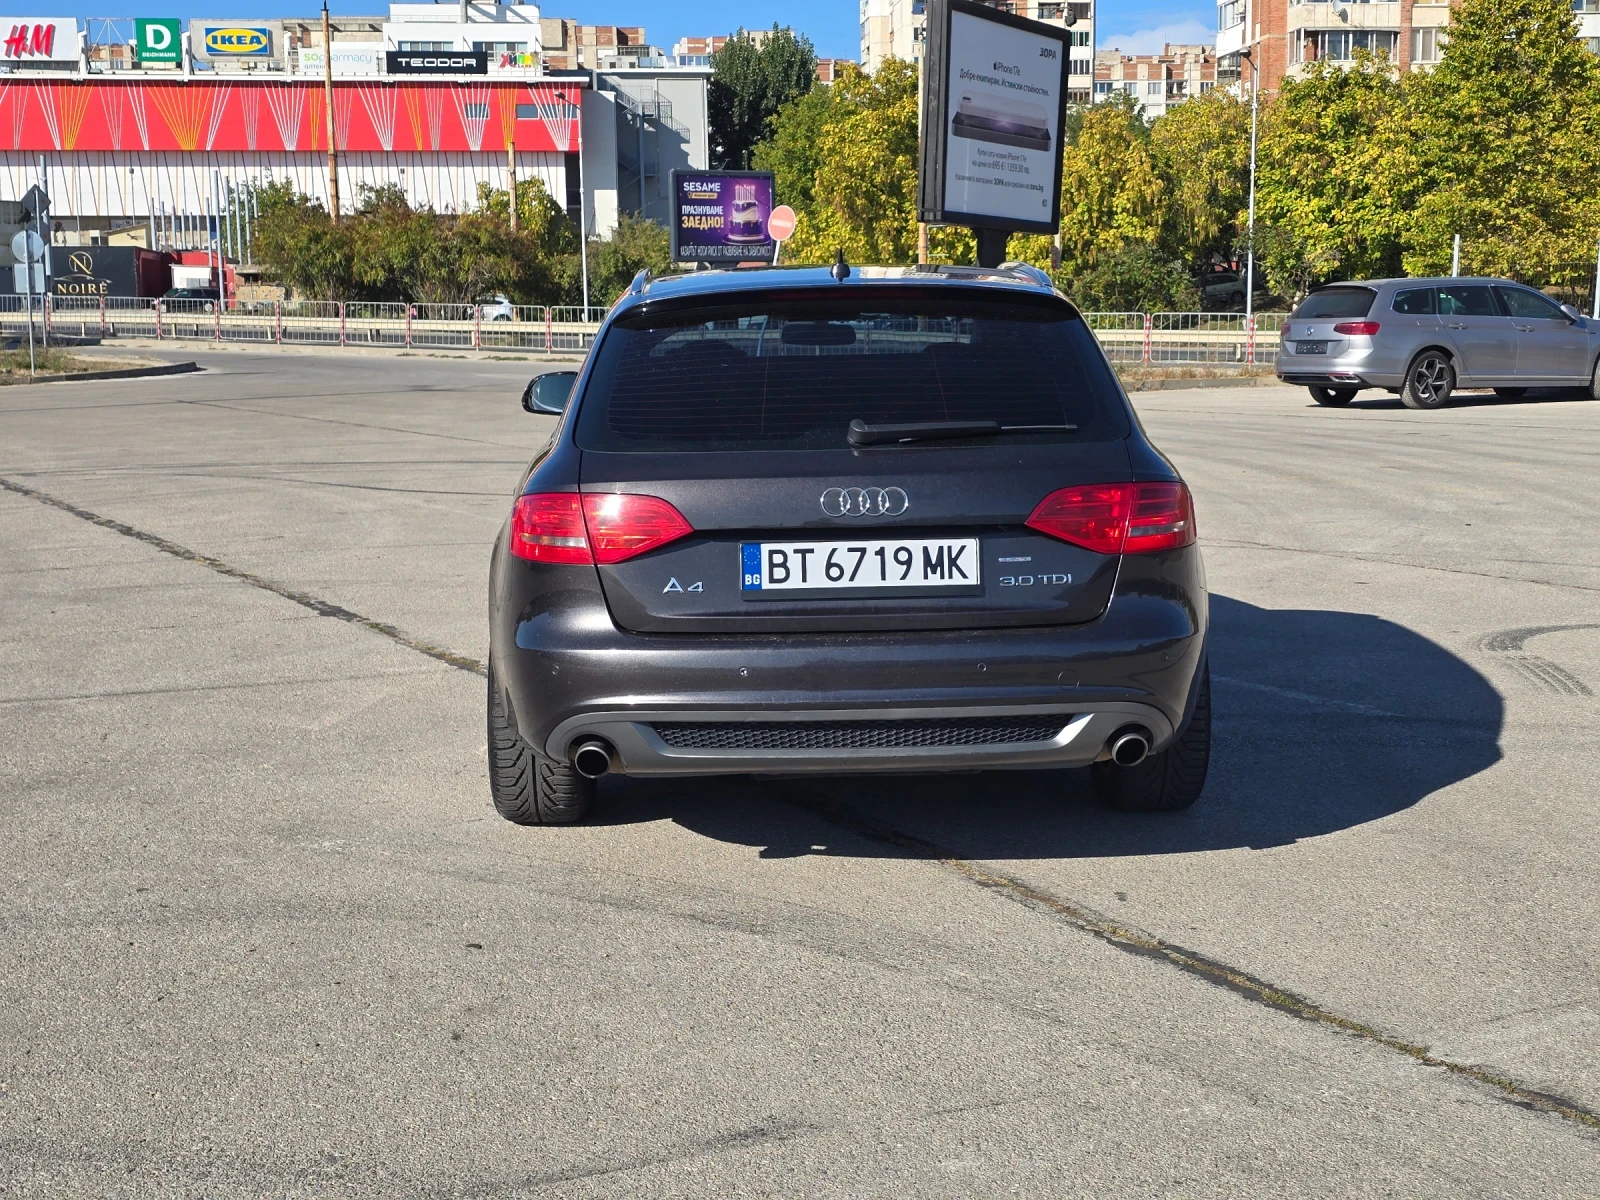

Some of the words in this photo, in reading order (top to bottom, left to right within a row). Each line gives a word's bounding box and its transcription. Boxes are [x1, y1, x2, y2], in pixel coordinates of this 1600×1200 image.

[3, 23, 53, 59] H&M
[211, 35, 263, 45] IKEA
[304, 53, 372, 64] soparmacy
[1039, 47, 1057, 60] ЗОРА
[397, 58, 477, 67] TEODOR
[996, 61, 1013, 75] iPhone
[959, 68, 976, 82] Добре
[992, 160, 1001, 170] 695
[683, 182, 721, 192] SESAME
[994, 177, 1004, 187] ЗОРА
[1030, 183, 1044, 193] zora.bg
[682, 205, 724, 215] ПРАЗНУВАМЕ
[682, 216, 725, 230] ЗАЕДНО!
[767, 548, 814, 584] BT
[823, 545, 914, 582] 6719
[923, 543, 970, 580] MK
[744, 574, 761, 585] BG
[999, 576, 1034, 587] 3.0
[1038, 573, 1072, 585] TDI
